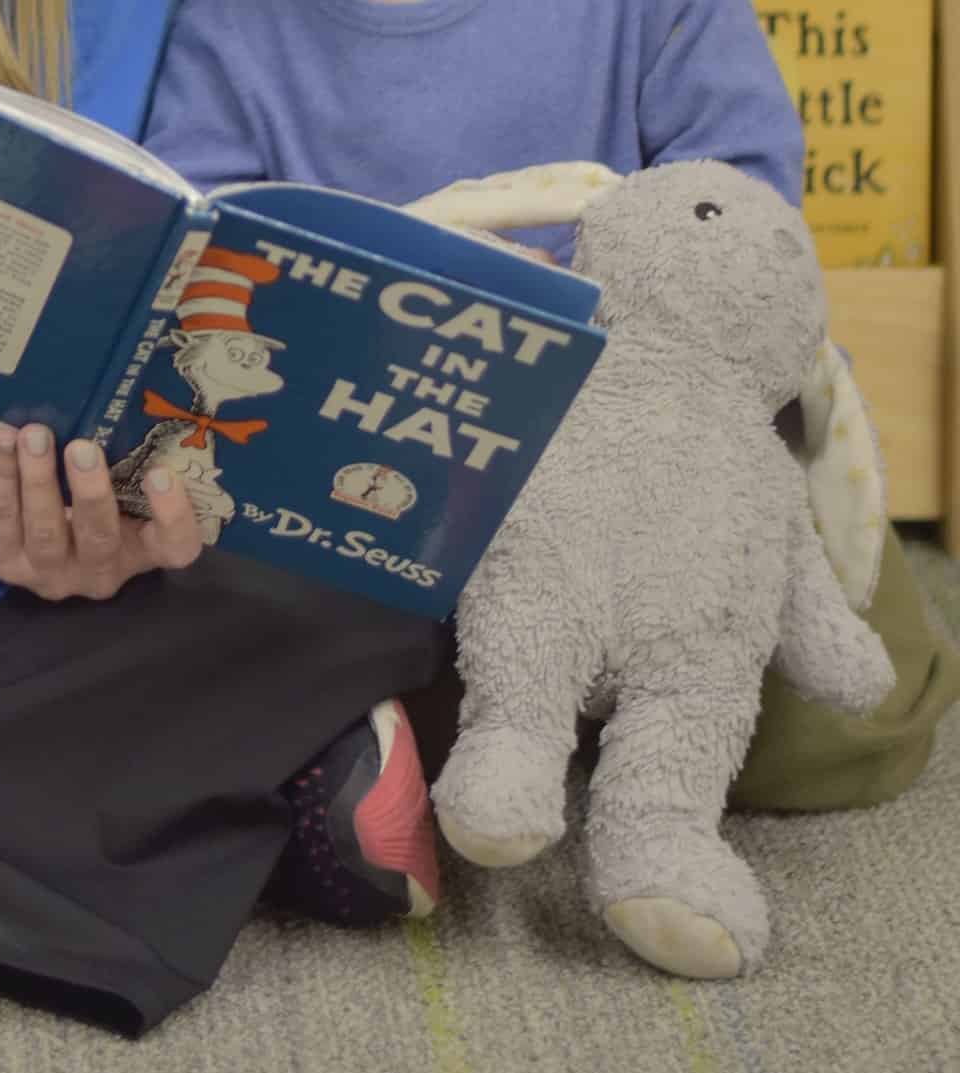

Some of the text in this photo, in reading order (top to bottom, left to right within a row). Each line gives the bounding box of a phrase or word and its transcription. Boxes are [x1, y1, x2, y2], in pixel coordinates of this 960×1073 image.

[759, 10, 870, 58] This
[799, 79, 883, 126] ttle
[804, 148, 887, 195] ick
[255, 240, 571, 366] THE CAT
[421, 345, 488, 382] IN
[386, 364, 491, 418] THE
[318, 378, 521, 471] HAT
[269, 507, 332, 548] Dr.
[336, 529, 443, 588] Seuss
